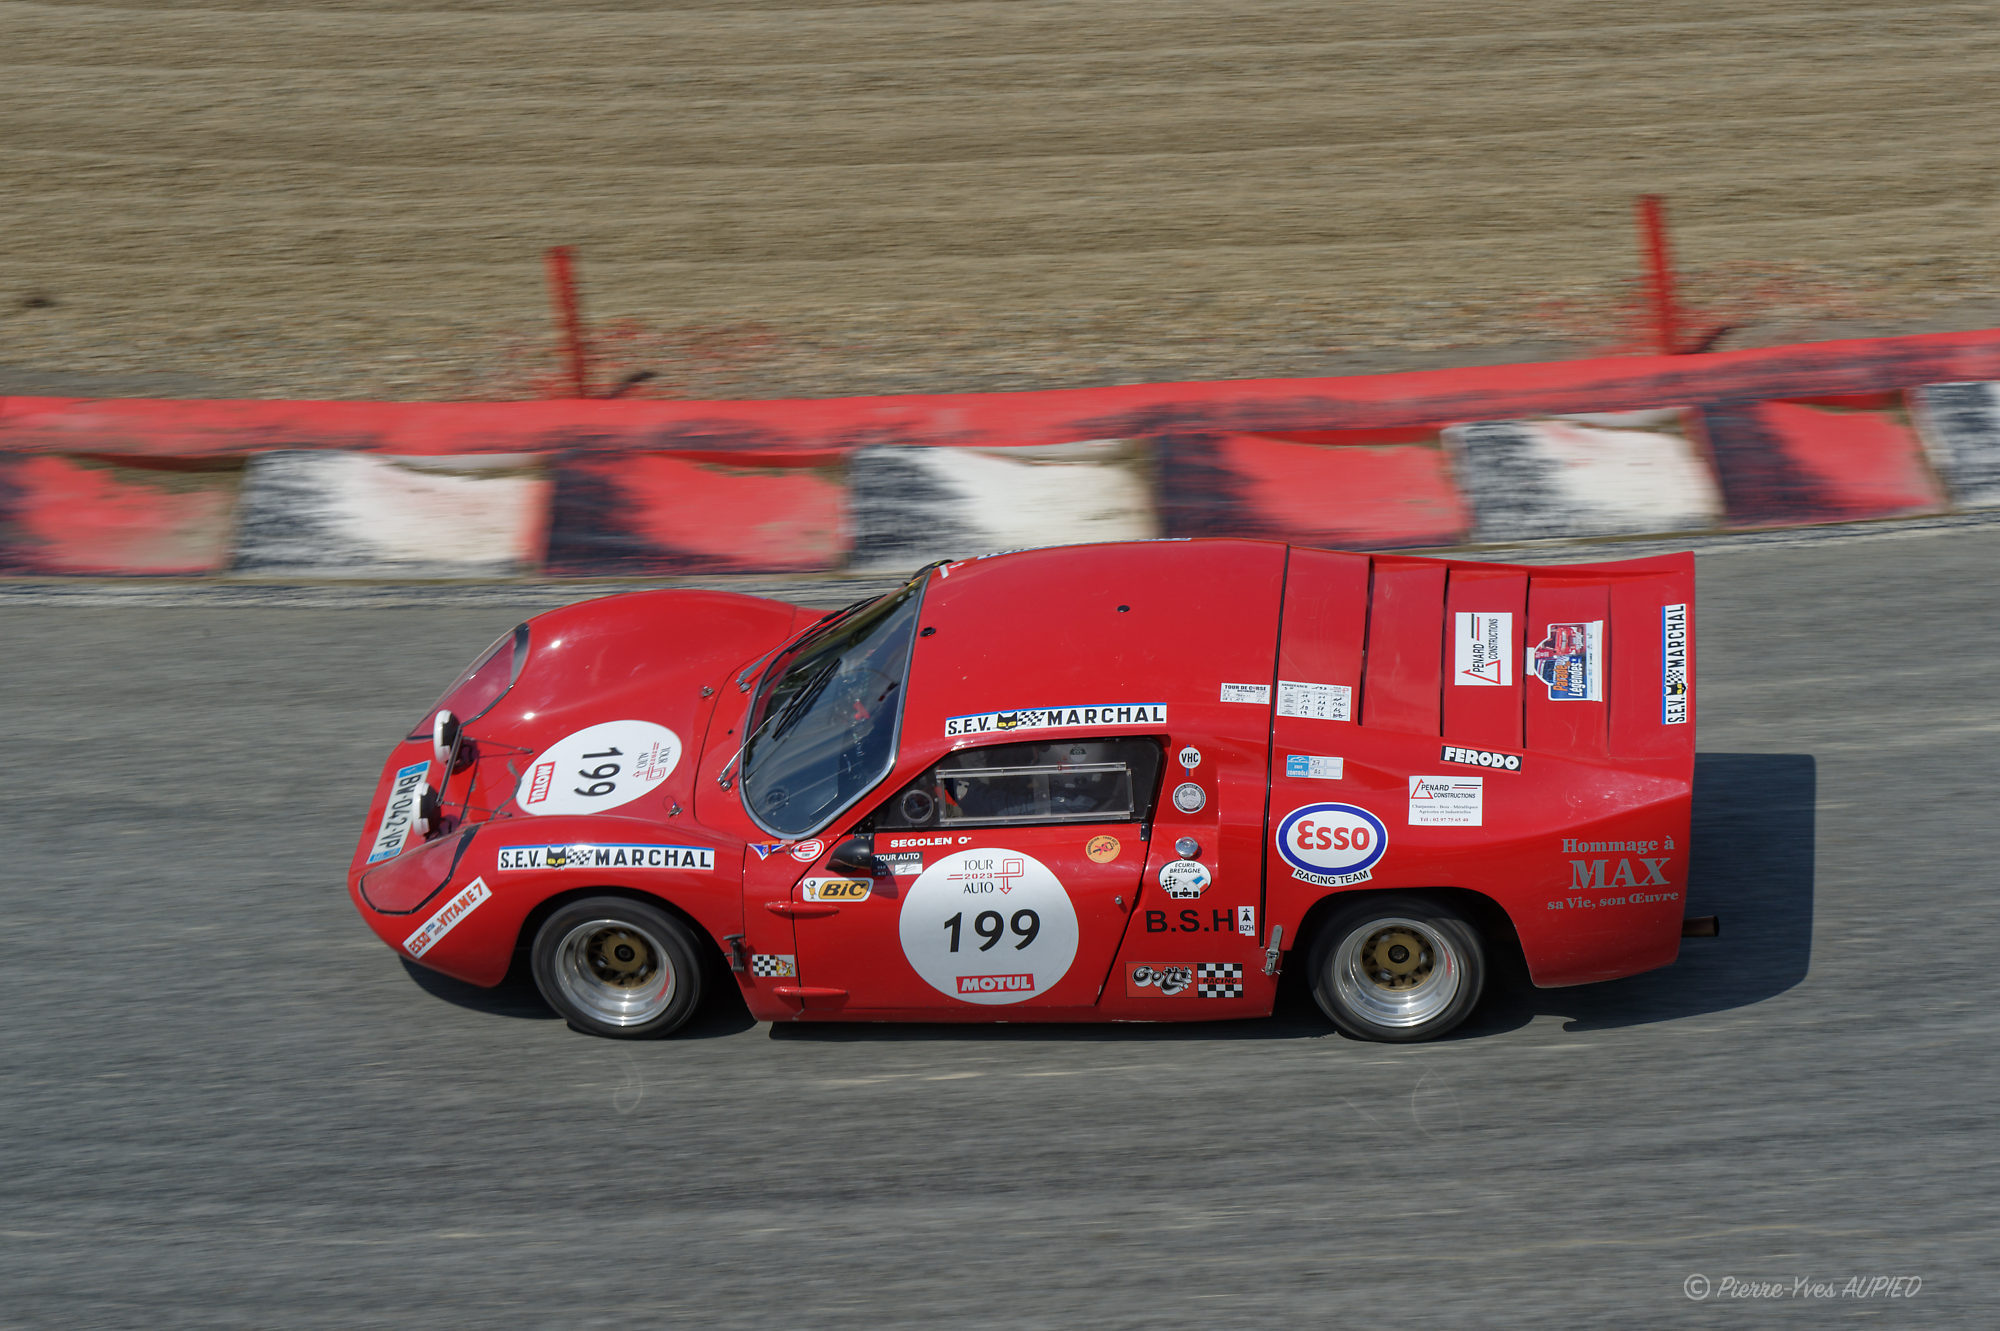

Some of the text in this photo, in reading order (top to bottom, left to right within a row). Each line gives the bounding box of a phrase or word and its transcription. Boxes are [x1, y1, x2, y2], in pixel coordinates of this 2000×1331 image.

[1488, 618, 1498, 660] CONSTRUCTIONS
[1473, 643, 1484, 673] PENARD
[1668, 605, 1685, 723] S.E.V. MARCHAL
[1553, 665, 1568, 691] Parade
[948, 706, 1164, 735] S.E.V. MARCHAL
[1181, 752, 1199, 763] VHC
[1444, 746, 1519, 770] FERODO
[573, 746, 624, 797] 199
[530, 765, 552, 802] MOTUL
[890, 837, 952, 848] SEGOLEN
[1561, 835, 1675, 855] Hommage à
[500, 849, 711, 868] S.E.V. MARCHAL
[875, 852, 920, 862] TOUR AUTO
[964, 859, 994, 871] TOUR
[1295, 869, 1369, 885] RACING TEAM
[1568, 857, 1671, 890] MAX
[473, 883, 483, 897] 7
[963, 881, 994, 894] AUTO
[1547, 892, 1679, 910] sa Vie, son Œuvre
[943, 908, 1041, 953] 199
[1145, 908, 1234, 933] B.S.H
[961, 975, 1031, 991] MOTUL
